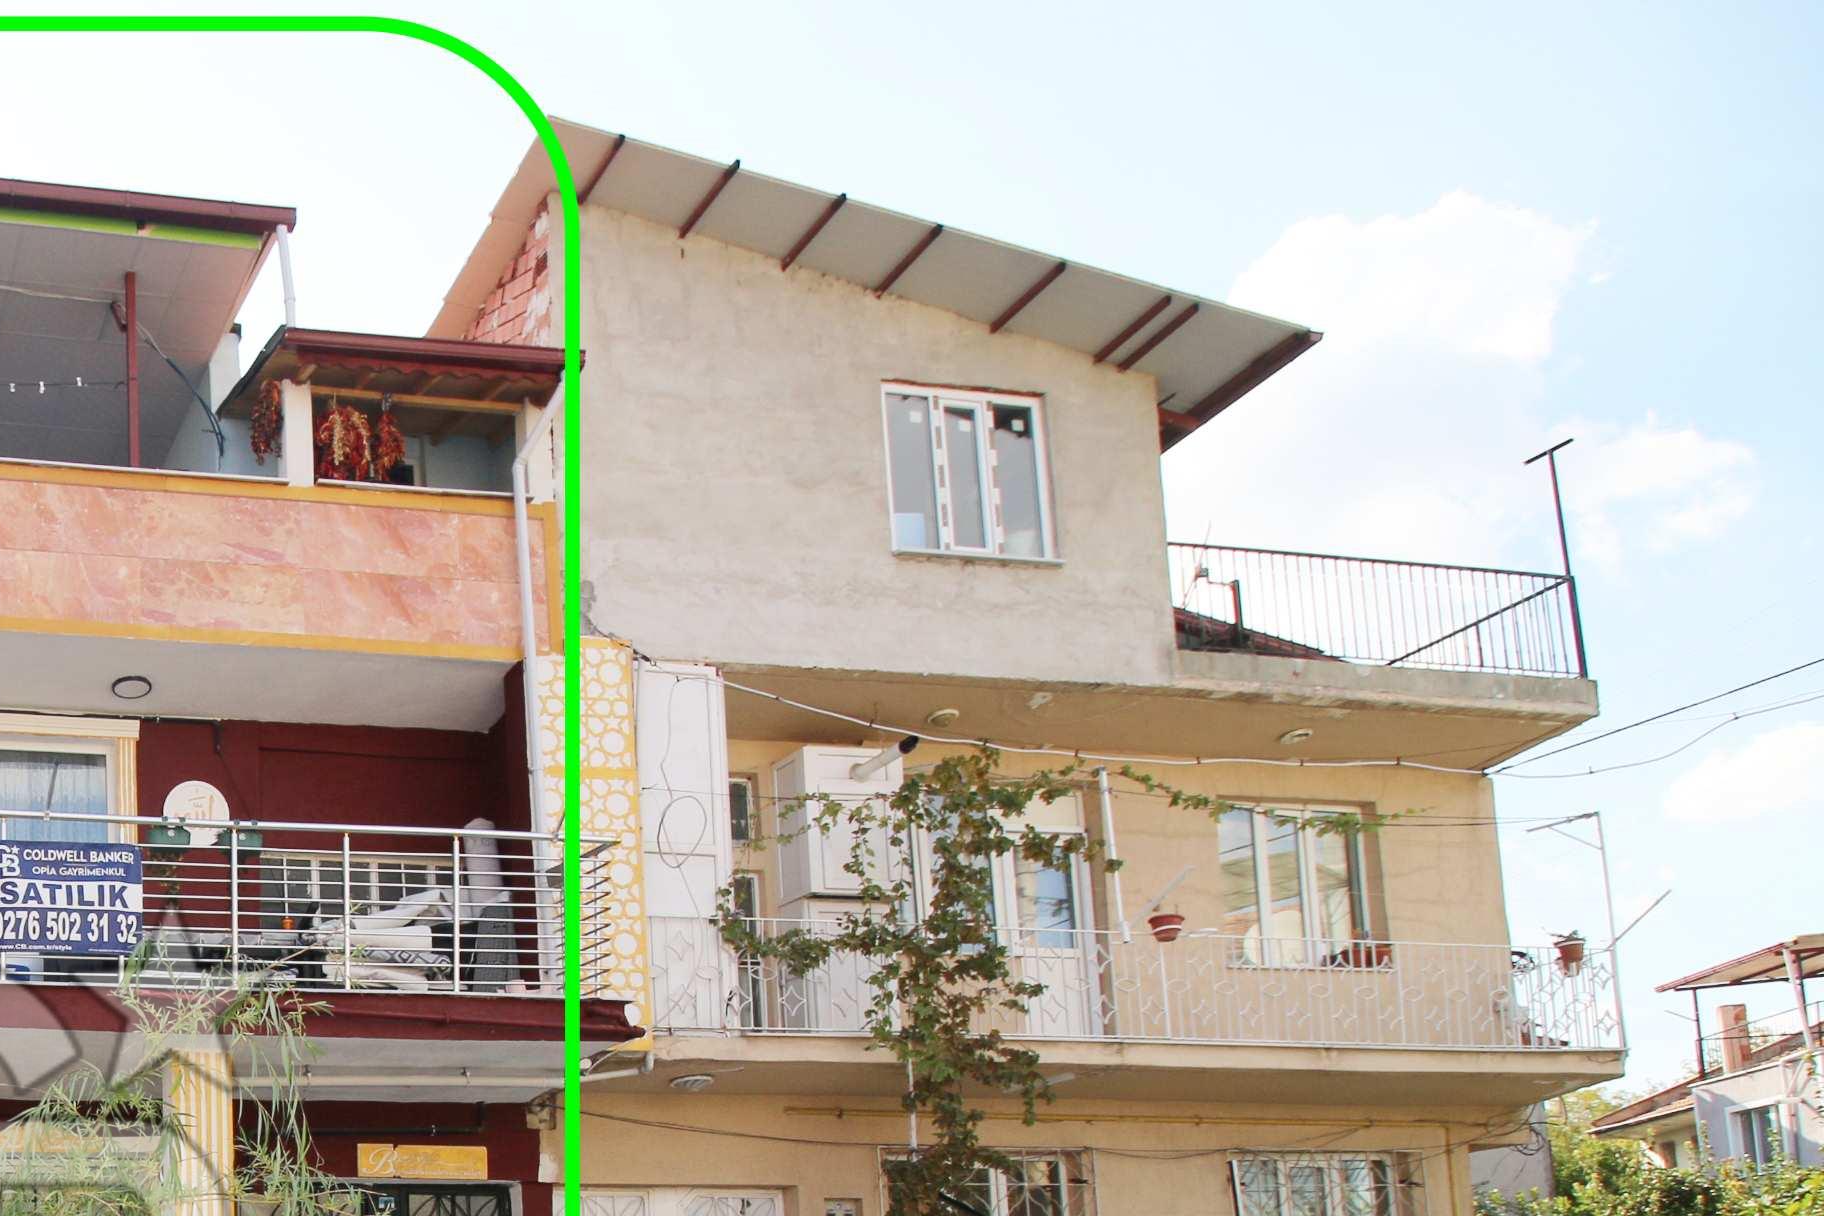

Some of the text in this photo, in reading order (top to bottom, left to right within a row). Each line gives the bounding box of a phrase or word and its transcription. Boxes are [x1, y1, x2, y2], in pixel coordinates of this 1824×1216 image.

[23, 848, 135, 865] COLDWELL BANKER
[32, 864, 127, 878] OPİA GAYRİMENKUL
[0, 880, 129, 909] SATILIK
[45, 911, 82, 943] 502
[87, 912, 110, 943] 31
[116, 914, 138, 945] 32
